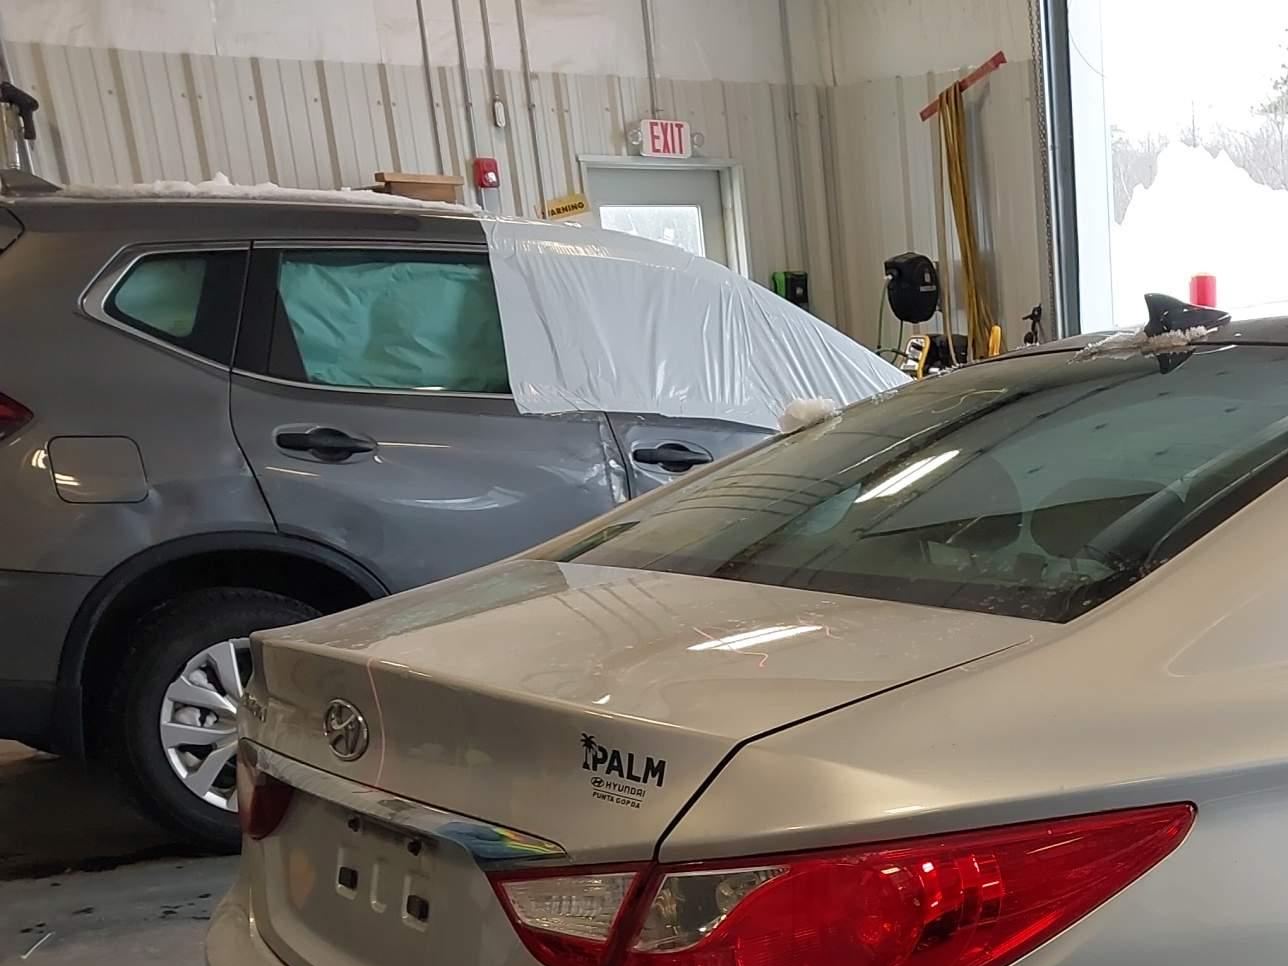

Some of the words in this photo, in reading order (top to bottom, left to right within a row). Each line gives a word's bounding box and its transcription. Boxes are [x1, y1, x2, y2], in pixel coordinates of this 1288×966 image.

[650, 121, 684, 154] EXIT
[592, 745, 666, 787] PALM
[592, 791, 614, 802] PUNTA
[605, 781, 646, 797] HYUNDAI
